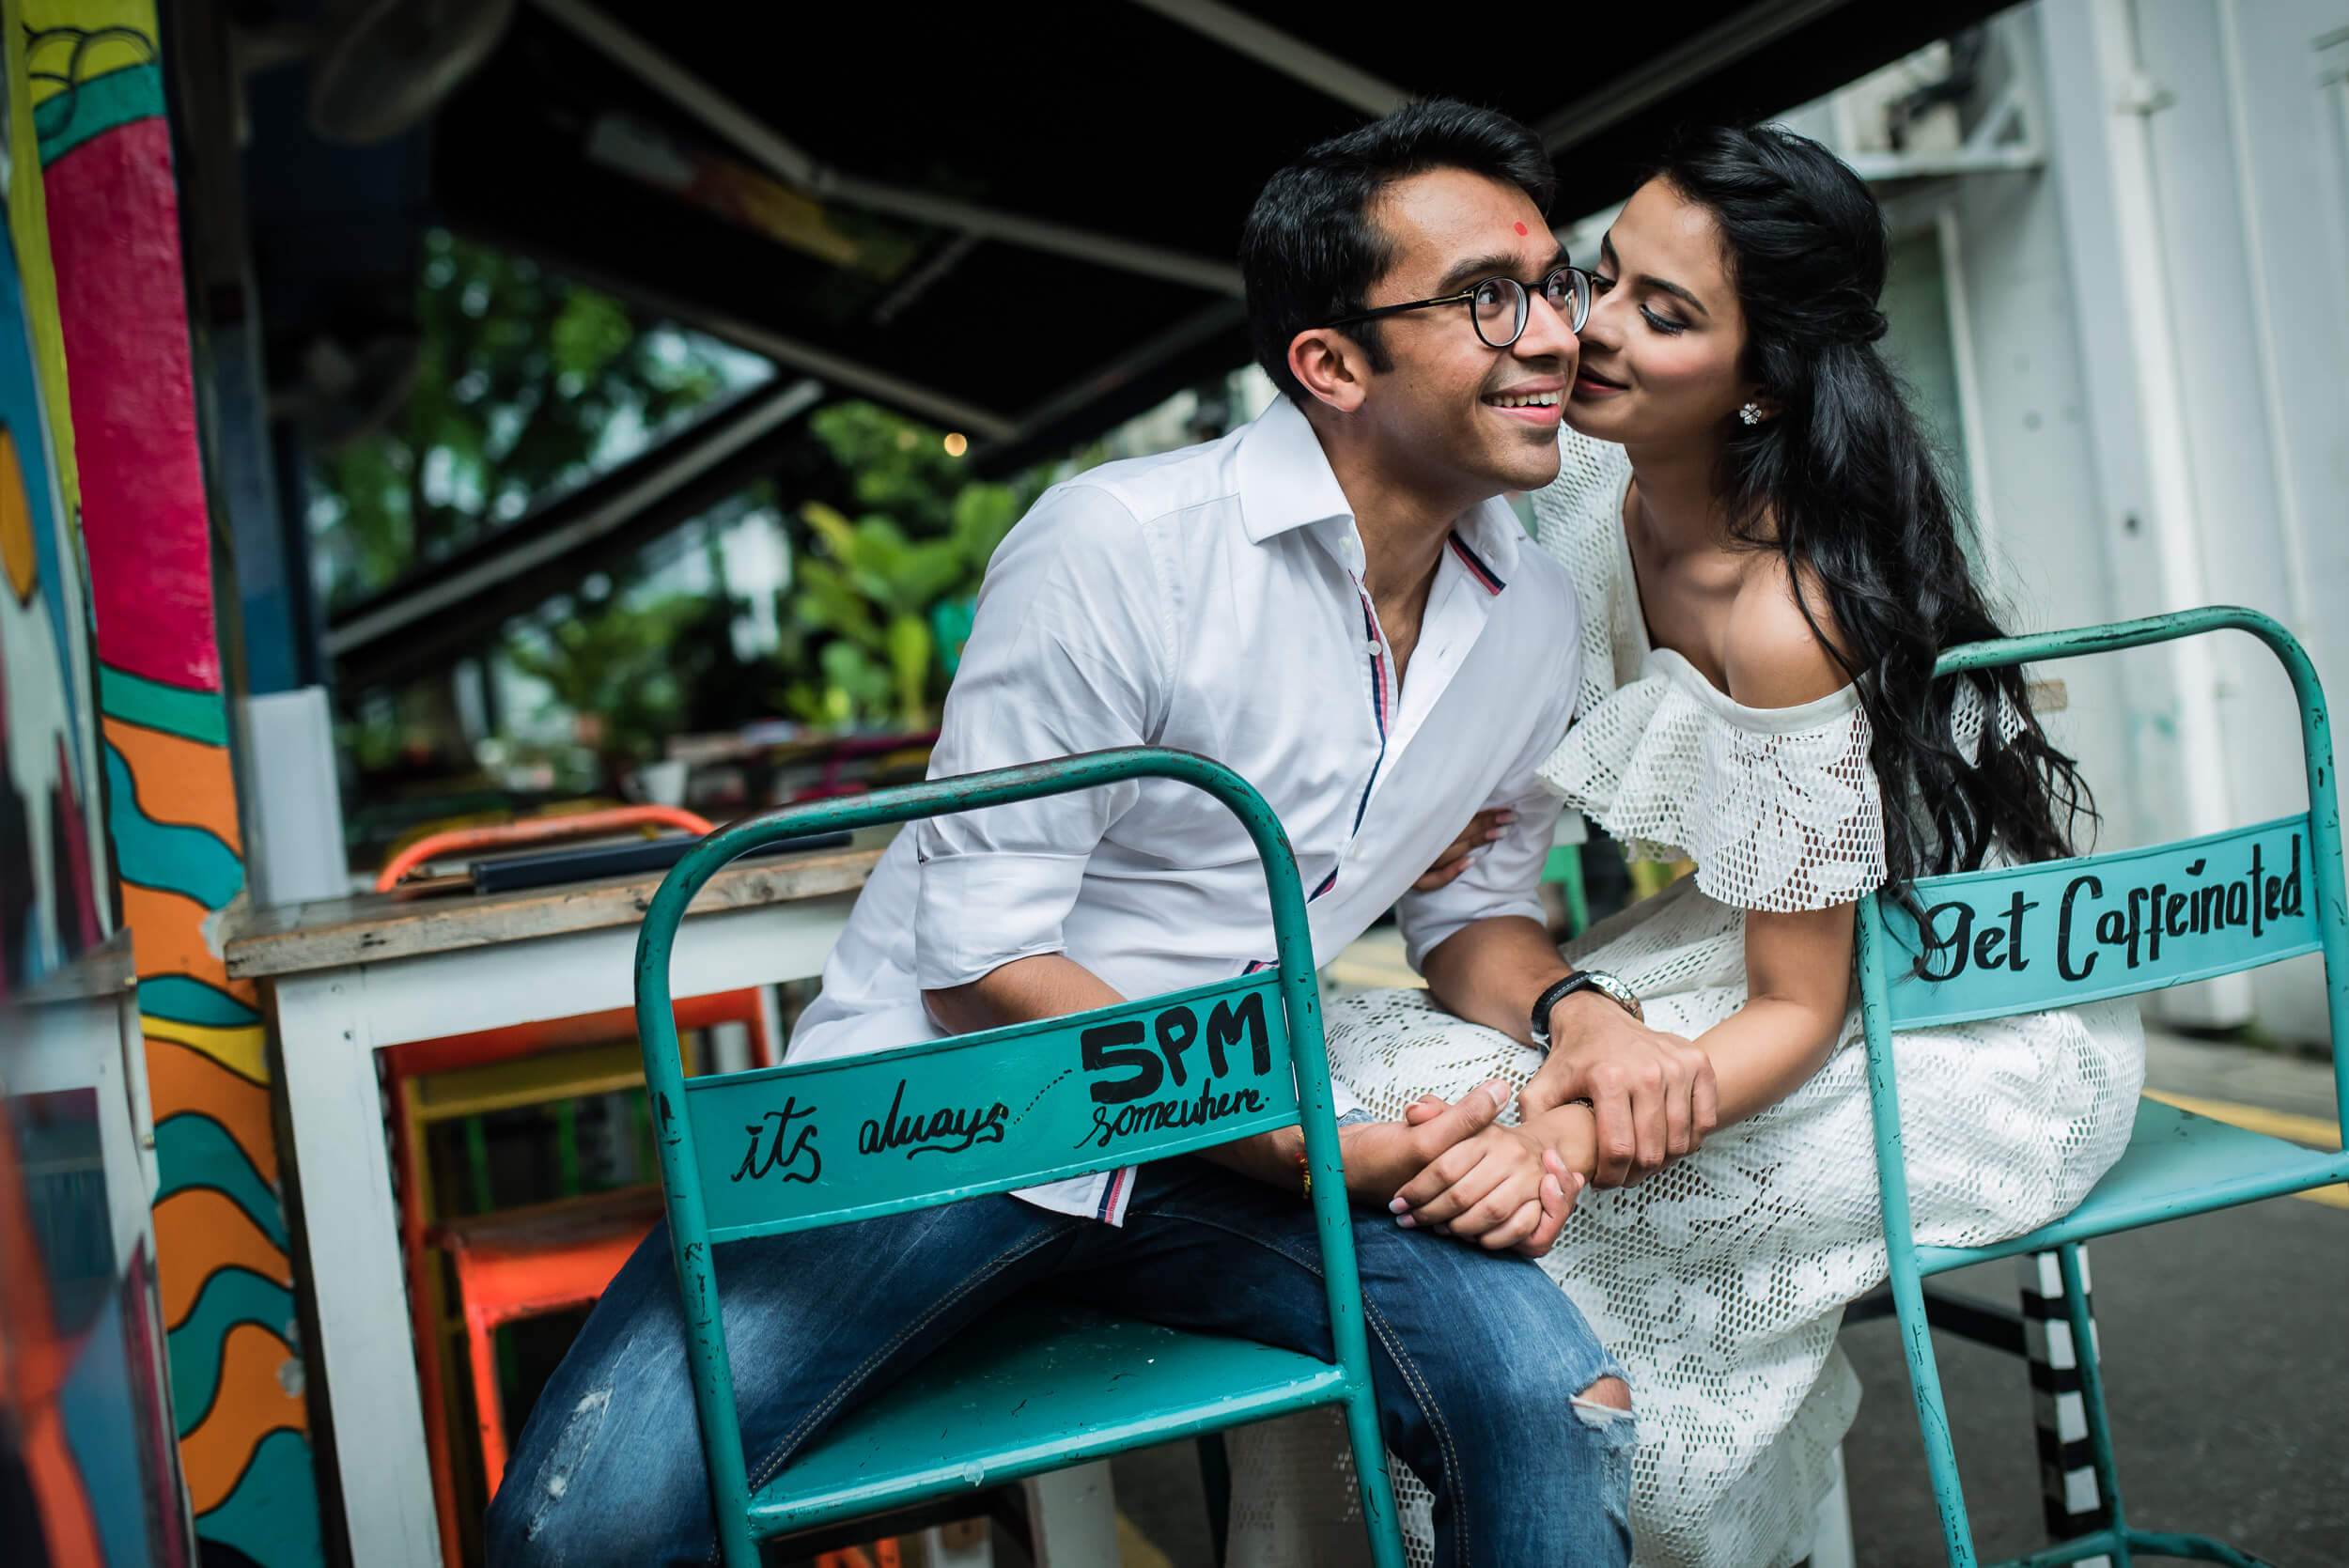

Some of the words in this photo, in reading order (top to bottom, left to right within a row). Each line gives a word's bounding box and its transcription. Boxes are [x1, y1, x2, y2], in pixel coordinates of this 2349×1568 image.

[2057, 833, 2305, 982] Caffeinated
[730, 1096, 821, 1183] its
[858, 1079, 1009, 1160] always
[1081, 992, 1271, 1104] 5PM
